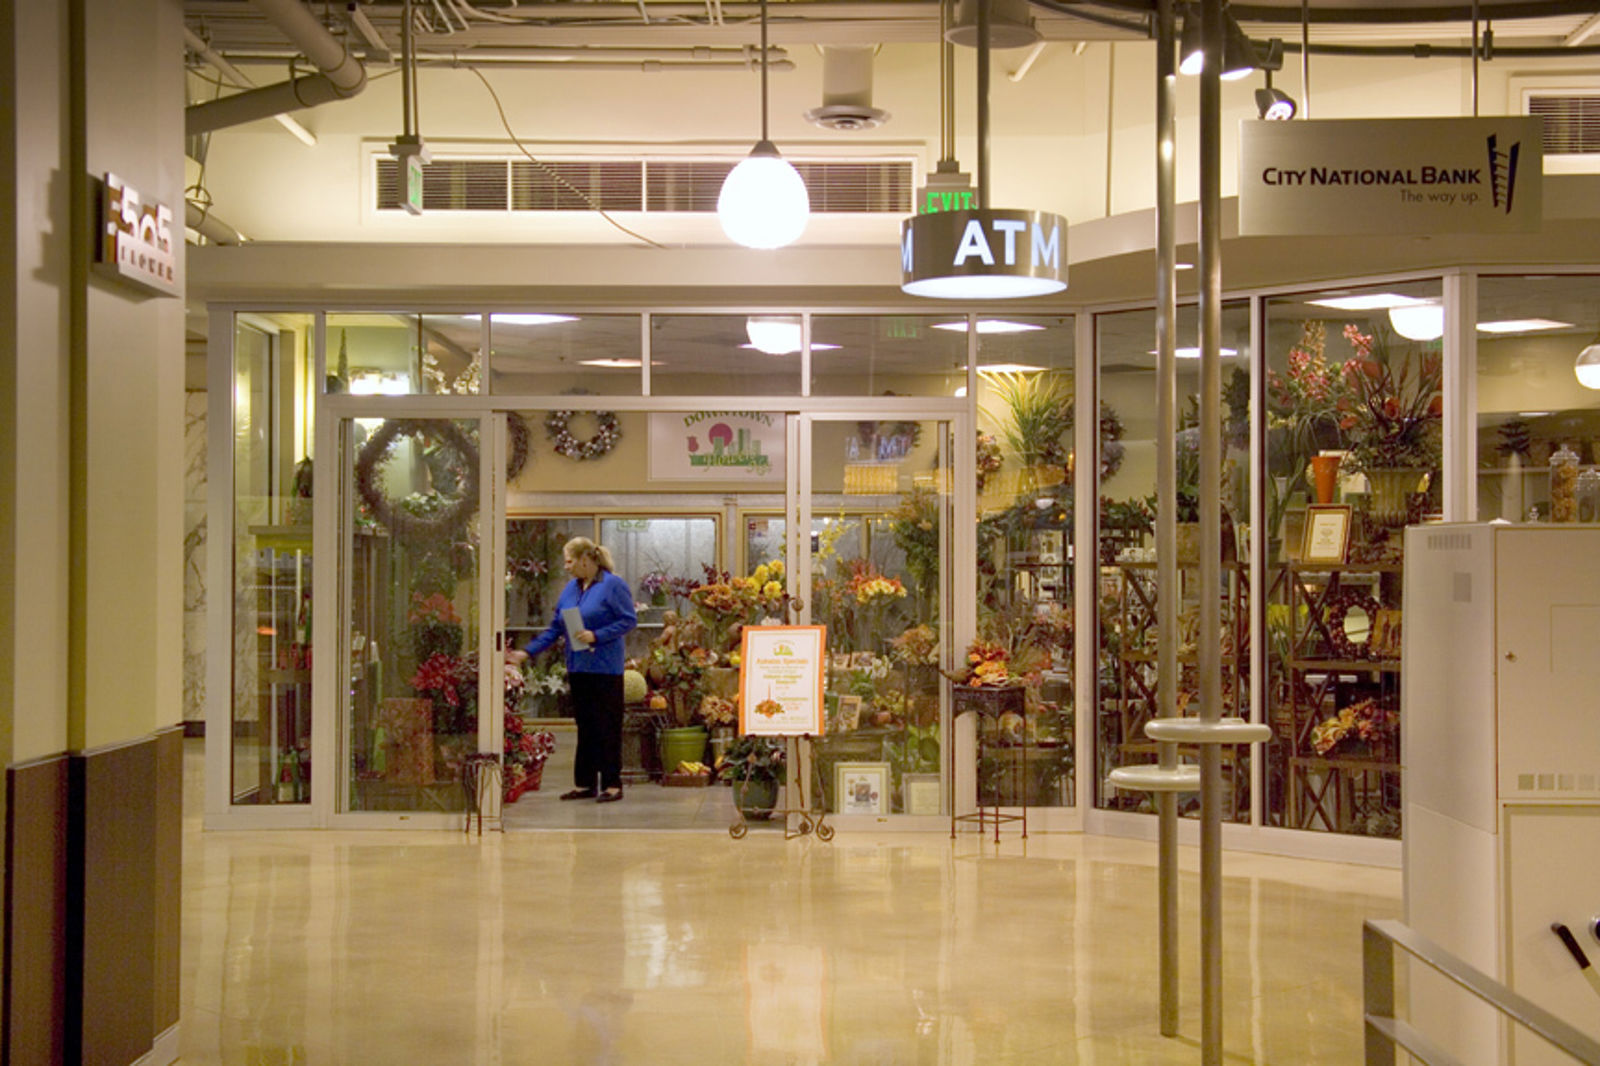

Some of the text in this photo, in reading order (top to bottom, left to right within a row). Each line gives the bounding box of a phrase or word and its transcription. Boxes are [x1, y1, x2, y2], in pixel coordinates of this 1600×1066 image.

[121, 185, 173, 254] 505
[1400, 189, 1423, 202] The
[1427, 192, 1456, 204] way
[953, 219, 1060, 270] ATM
